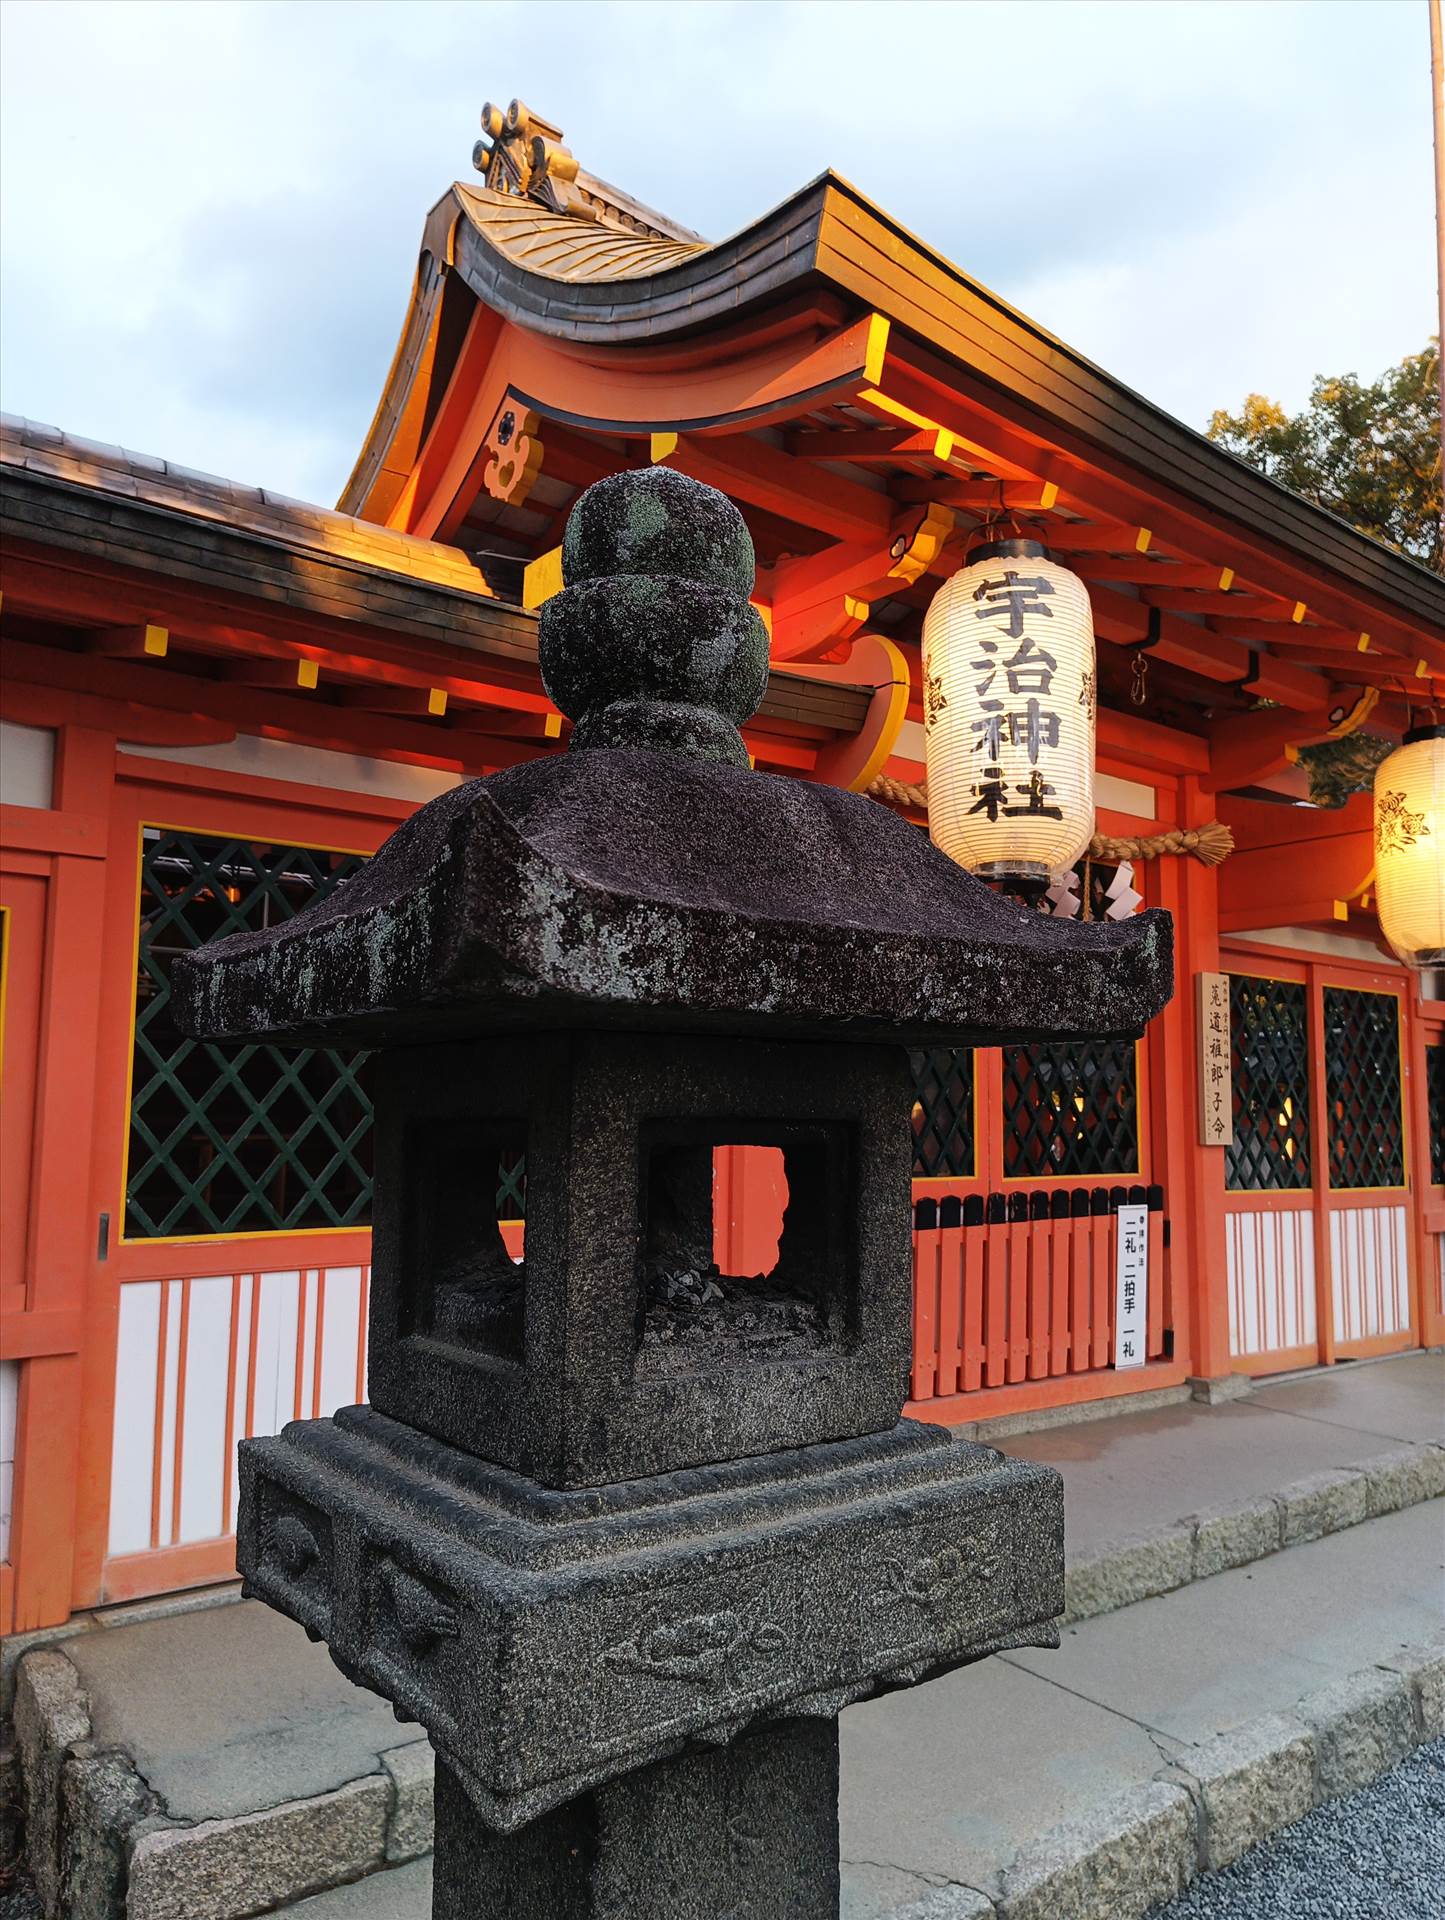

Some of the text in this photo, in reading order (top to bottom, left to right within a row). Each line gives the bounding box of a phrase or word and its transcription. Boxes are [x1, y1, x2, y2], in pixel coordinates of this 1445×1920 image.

[963, 571, 1063, 823] 宇治神社
[1123, 1221, 1137, 1358] 二礼 二拍手 一礼
